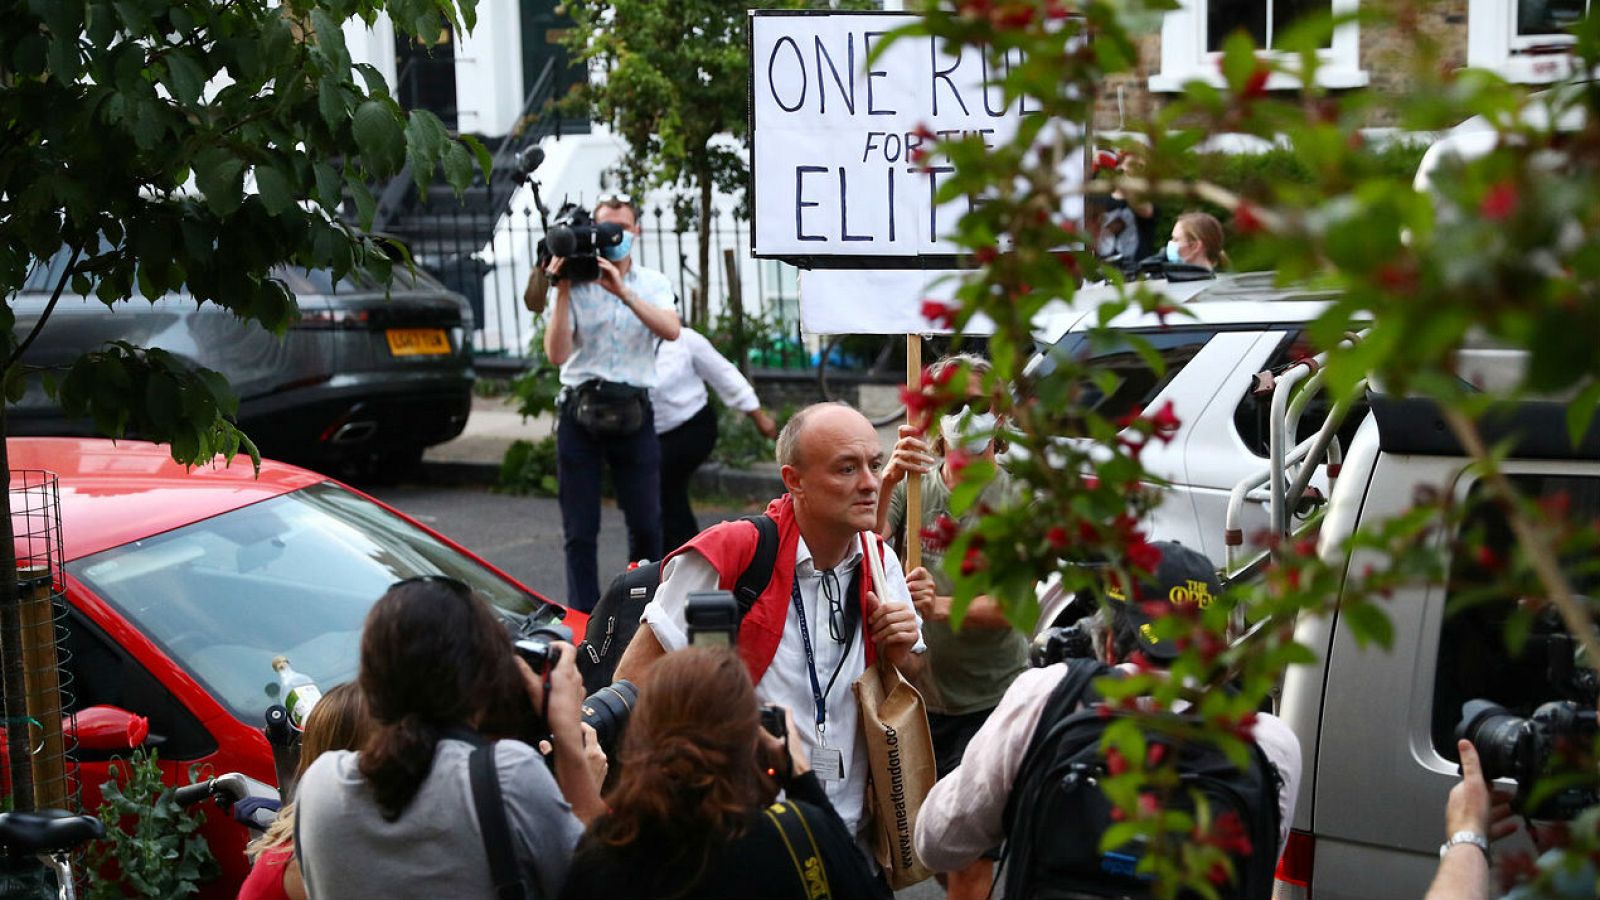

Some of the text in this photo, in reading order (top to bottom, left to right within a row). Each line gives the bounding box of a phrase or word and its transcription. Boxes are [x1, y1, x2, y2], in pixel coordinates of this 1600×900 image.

[768, 31, 1044, 118] ONE RUL
[862, 128, 995, 163] FOR TE
[881, 722, 913, 870] www.meatlondon.co
